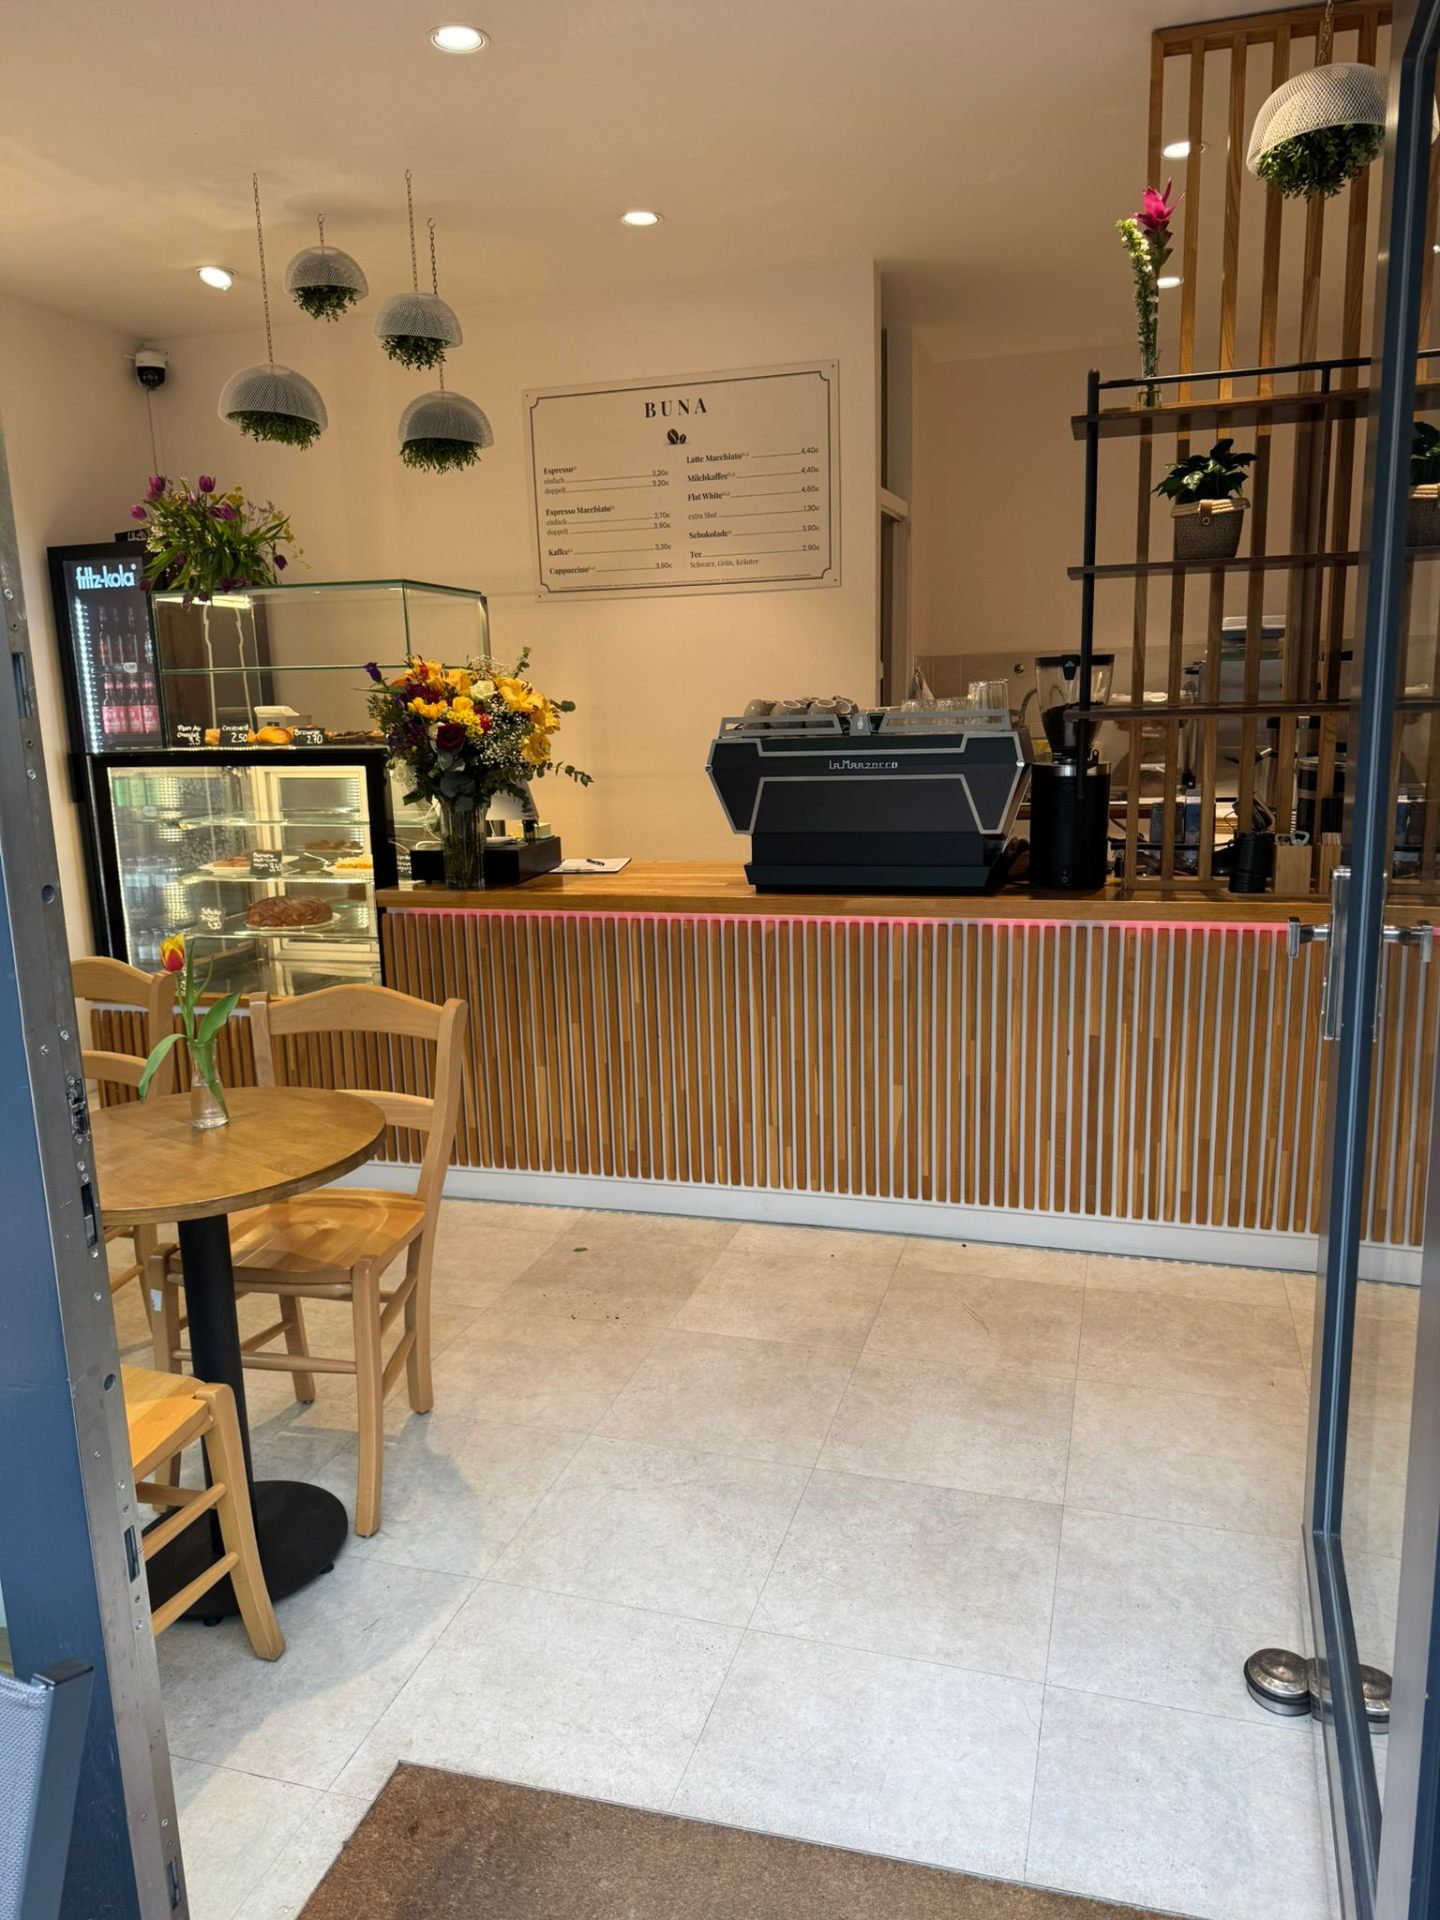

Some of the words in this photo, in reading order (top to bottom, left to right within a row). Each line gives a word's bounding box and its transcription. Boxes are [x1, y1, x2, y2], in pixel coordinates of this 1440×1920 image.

[645, 397, 707, 418] BUNA
[686, 455, 704, 464] Latte
[688, 493, 701, 502] Flat
[702, 492, 723, 500] White
[704, 511, 717, 520] Shot
